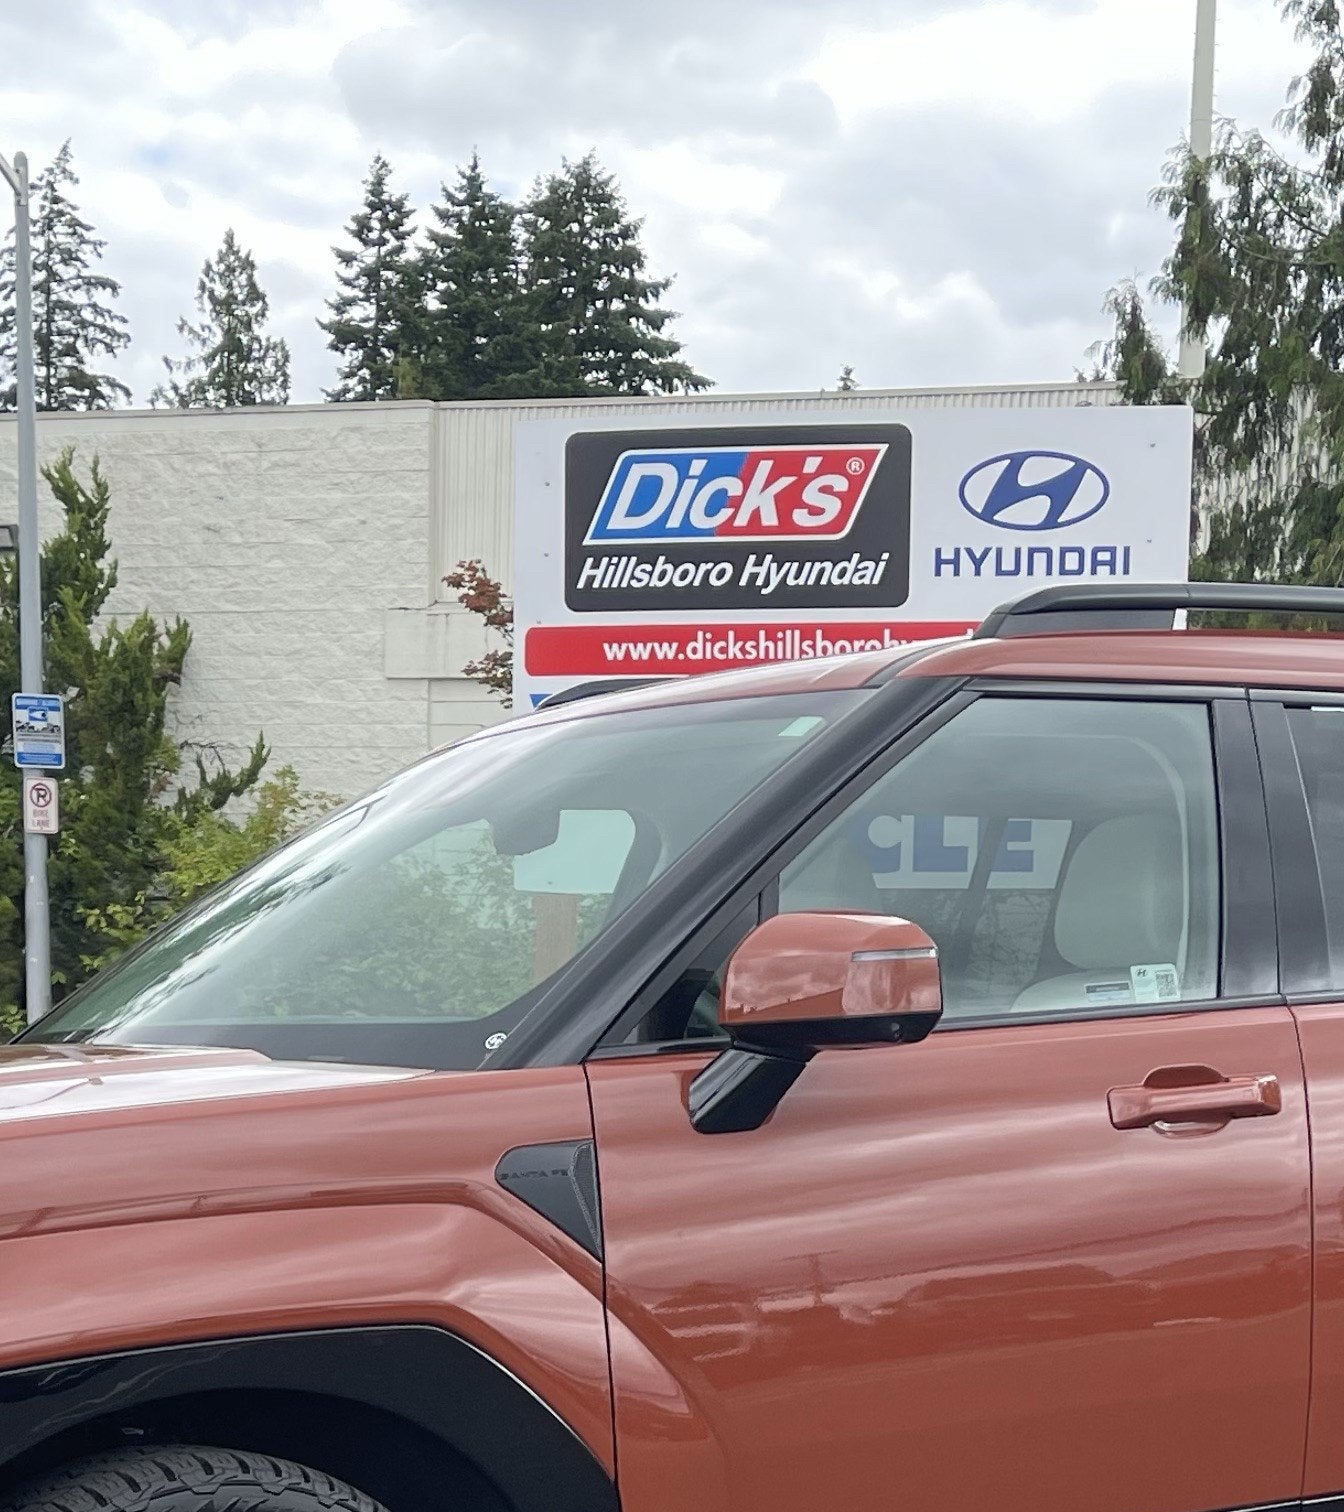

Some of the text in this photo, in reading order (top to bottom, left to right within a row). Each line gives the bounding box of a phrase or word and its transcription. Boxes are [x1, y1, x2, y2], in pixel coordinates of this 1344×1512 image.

[606, 456, 850, 530] Dick's
[576, 553, 890, 595] Hillsboro Hyundai
[934, 546, 1131, 577] HYUNDAI
